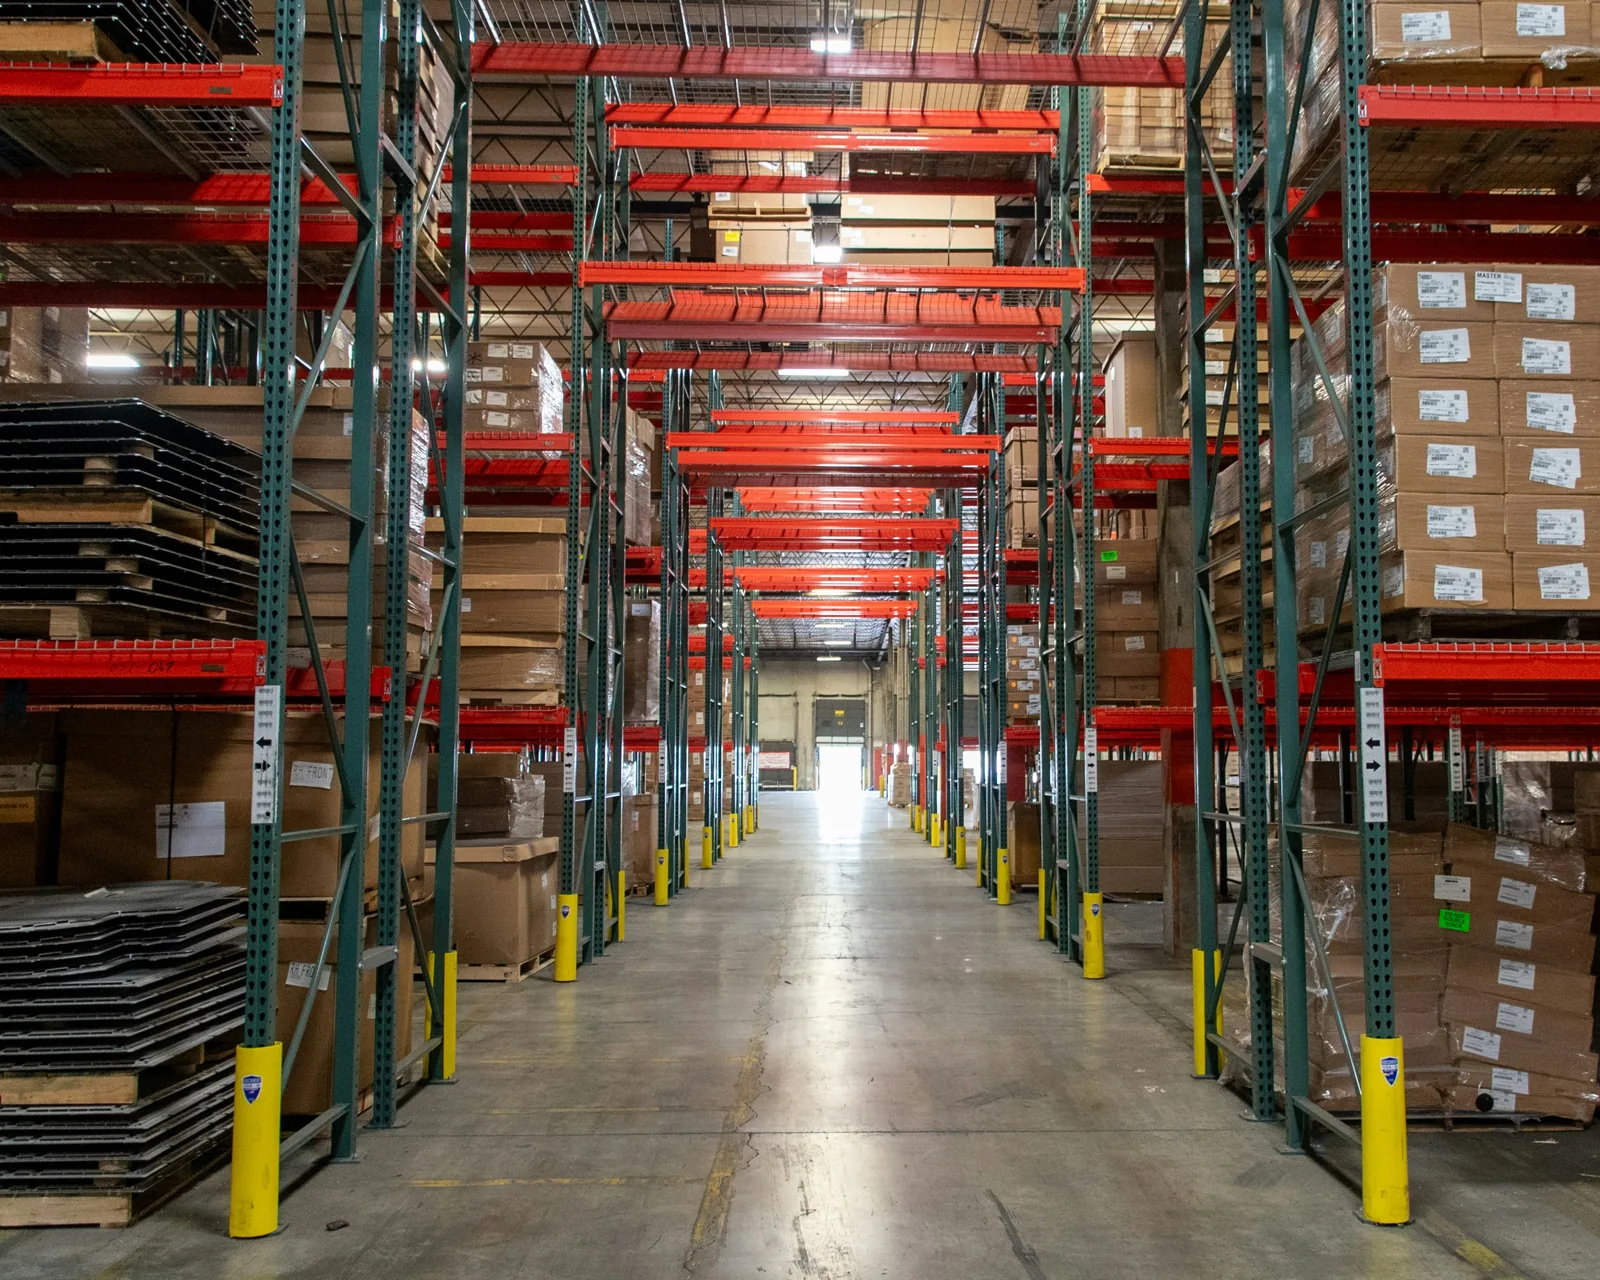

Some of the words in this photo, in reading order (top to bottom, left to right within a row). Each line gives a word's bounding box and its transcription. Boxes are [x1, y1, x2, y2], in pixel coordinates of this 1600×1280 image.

[293, 764, 304, 777] RH
[307, 765, 333, 780] FRONT
[289, 963, 300, 976] RH
